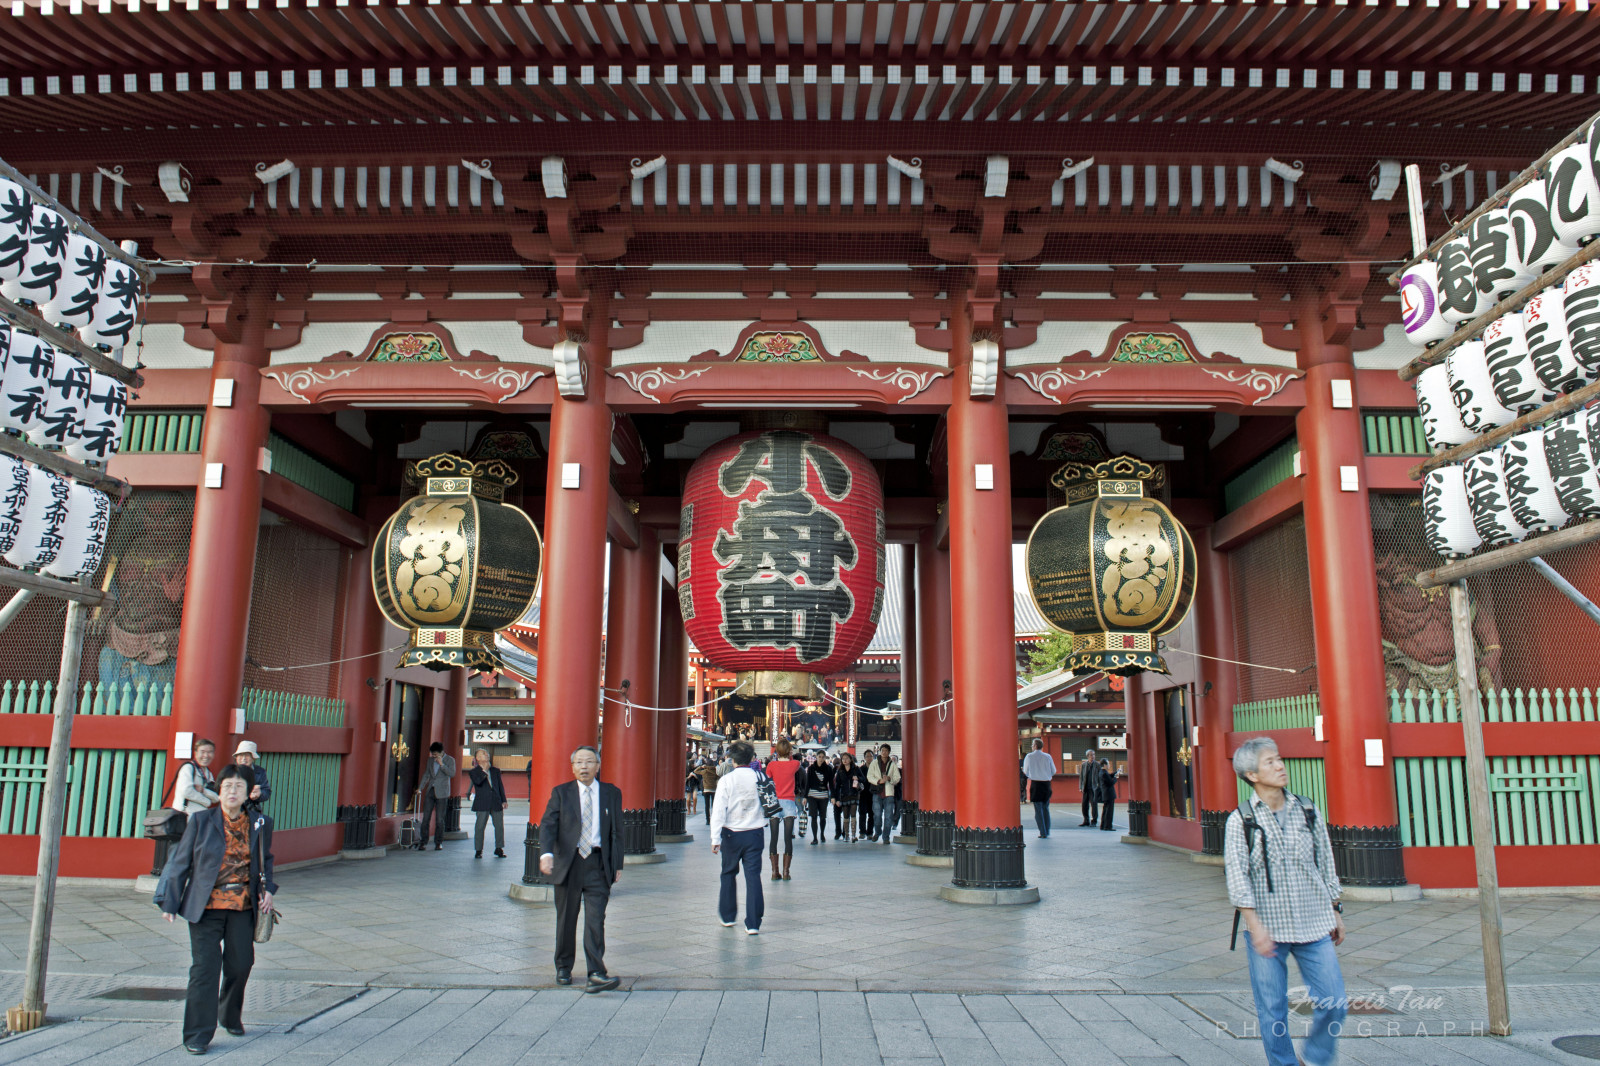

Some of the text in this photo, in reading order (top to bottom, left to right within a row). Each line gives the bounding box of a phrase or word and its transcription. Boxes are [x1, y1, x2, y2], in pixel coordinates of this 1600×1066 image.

[20, 213, 69, 300] 米久
[61, 245, 106, 325] 米久
[97, 268, 141, 346] 米久
[0, 465, 30, 555] 宮本卯之助商
[712, 430, 858, 664] 小舟町
[475, 730, 506, 740] みくじ
[1101, 738, 1119, 747] みく
